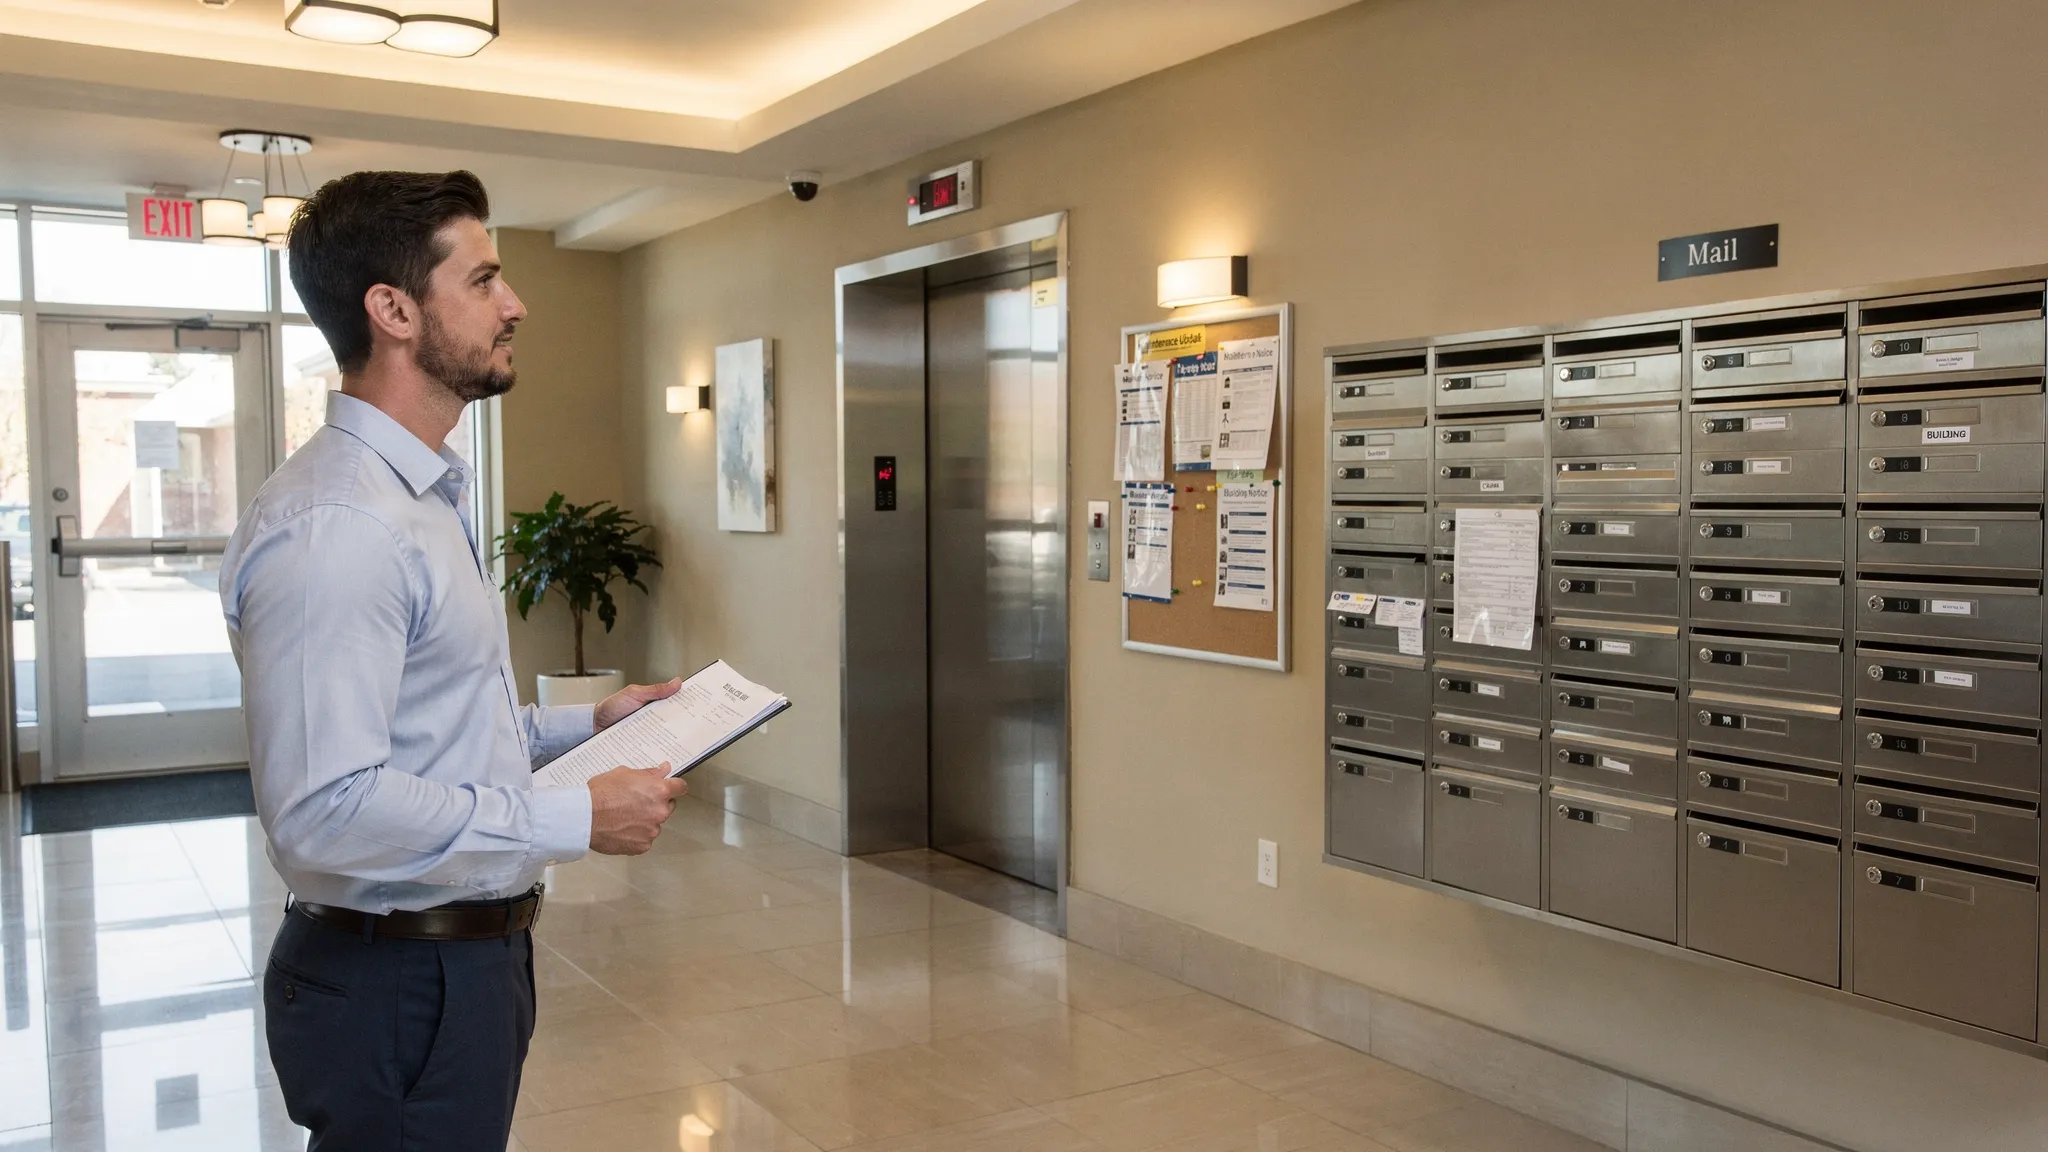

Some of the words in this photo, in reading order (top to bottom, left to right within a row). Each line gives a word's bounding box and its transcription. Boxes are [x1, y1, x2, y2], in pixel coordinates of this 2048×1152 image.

[143, 198, 194, 238] EXIT
[1688, 237, 1738, 266] Mail
[1899, 342, 1910, 352] 10
[1898, 530, 1909, 541] 15
[1898, 600, 1909, 611] 10
[1896, 670, 1908, 681] 12
[1895, 739, 1907, 750] 16
[1895, 875, 1902, 885] 7
